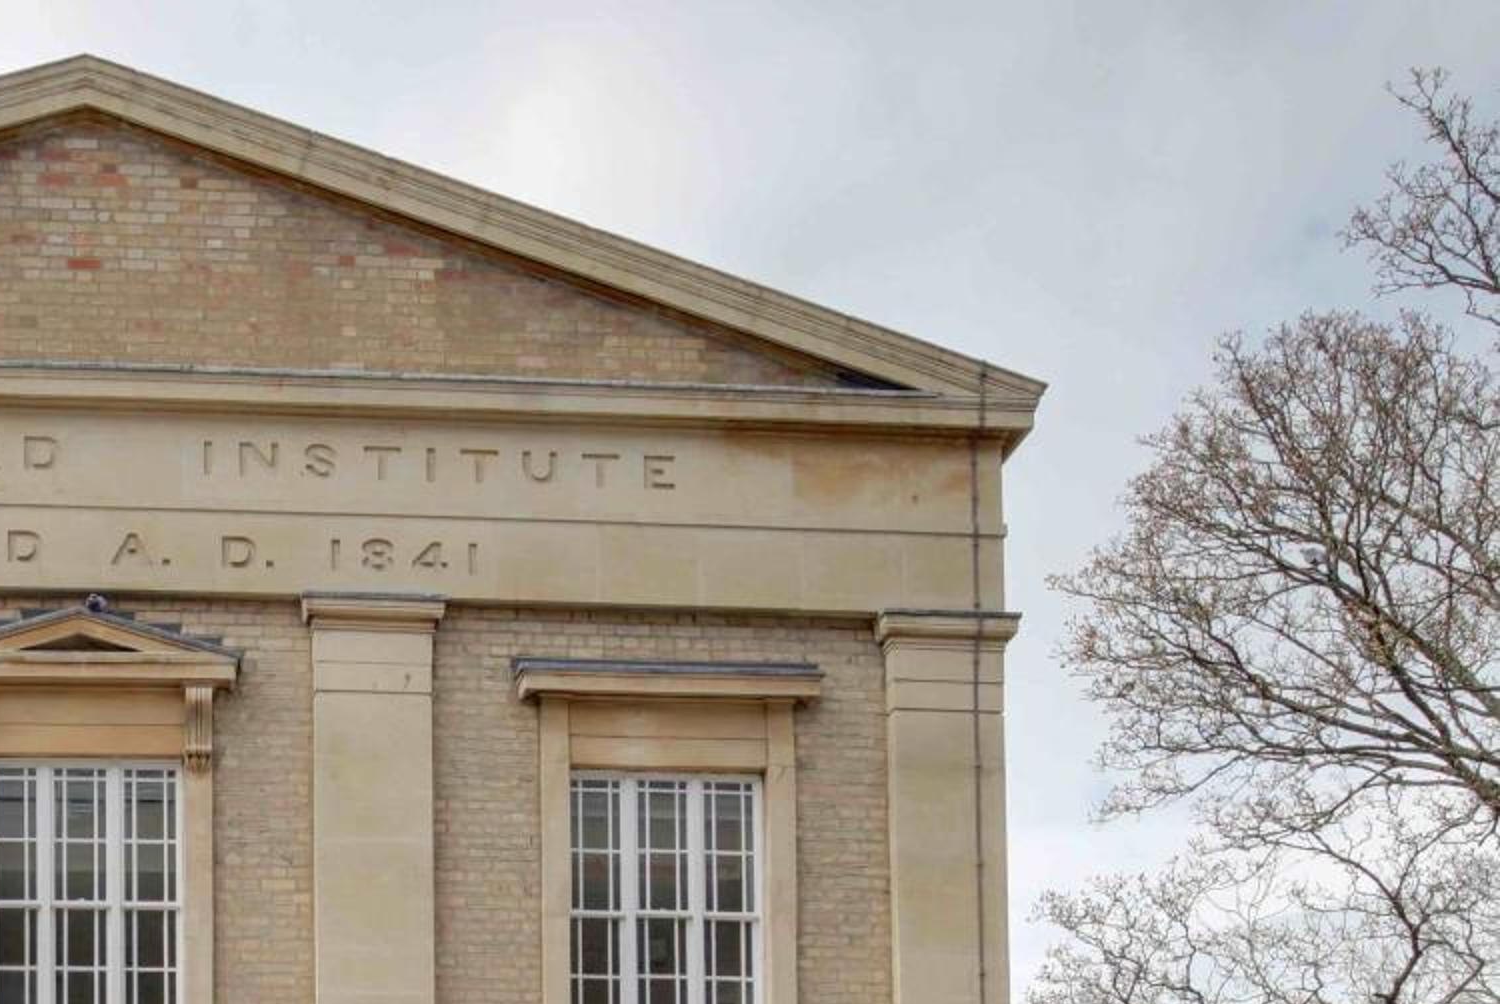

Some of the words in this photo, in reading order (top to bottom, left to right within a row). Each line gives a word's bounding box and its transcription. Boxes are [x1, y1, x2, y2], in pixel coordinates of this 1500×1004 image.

[202, 440, 676, 490] INSTITUTE
[110, 532, 172, 568] A.
[220, 534, 276, 569] D.
[329, 538, 480, 575] 1841
